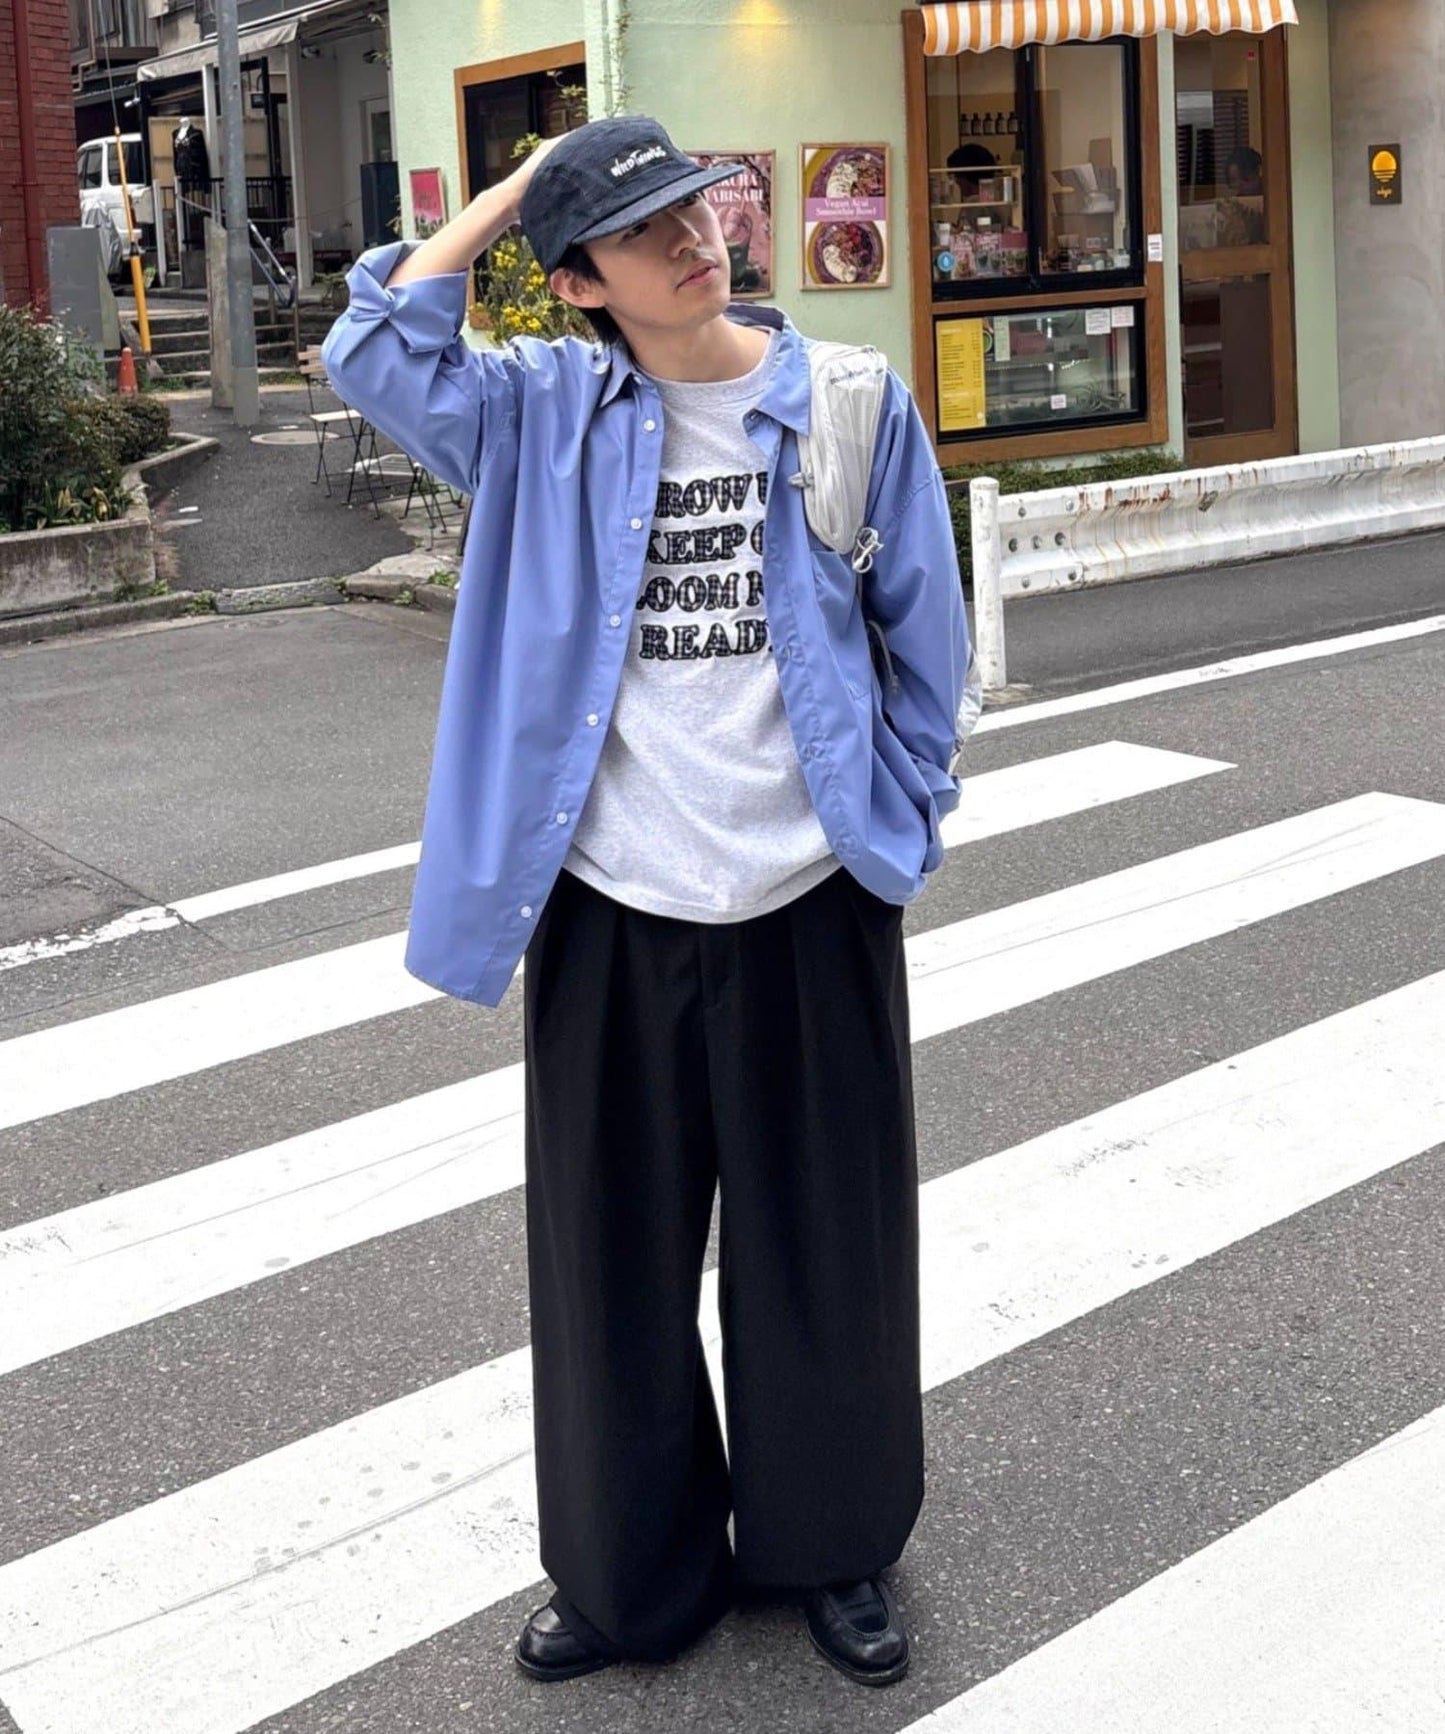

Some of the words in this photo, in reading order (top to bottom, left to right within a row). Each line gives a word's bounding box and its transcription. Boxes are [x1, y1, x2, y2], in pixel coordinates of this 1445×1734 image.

[654, 473, 753, 519] ROW
[636, 572, 740, 613] OOM
[638, 618, 773, 661] READ
